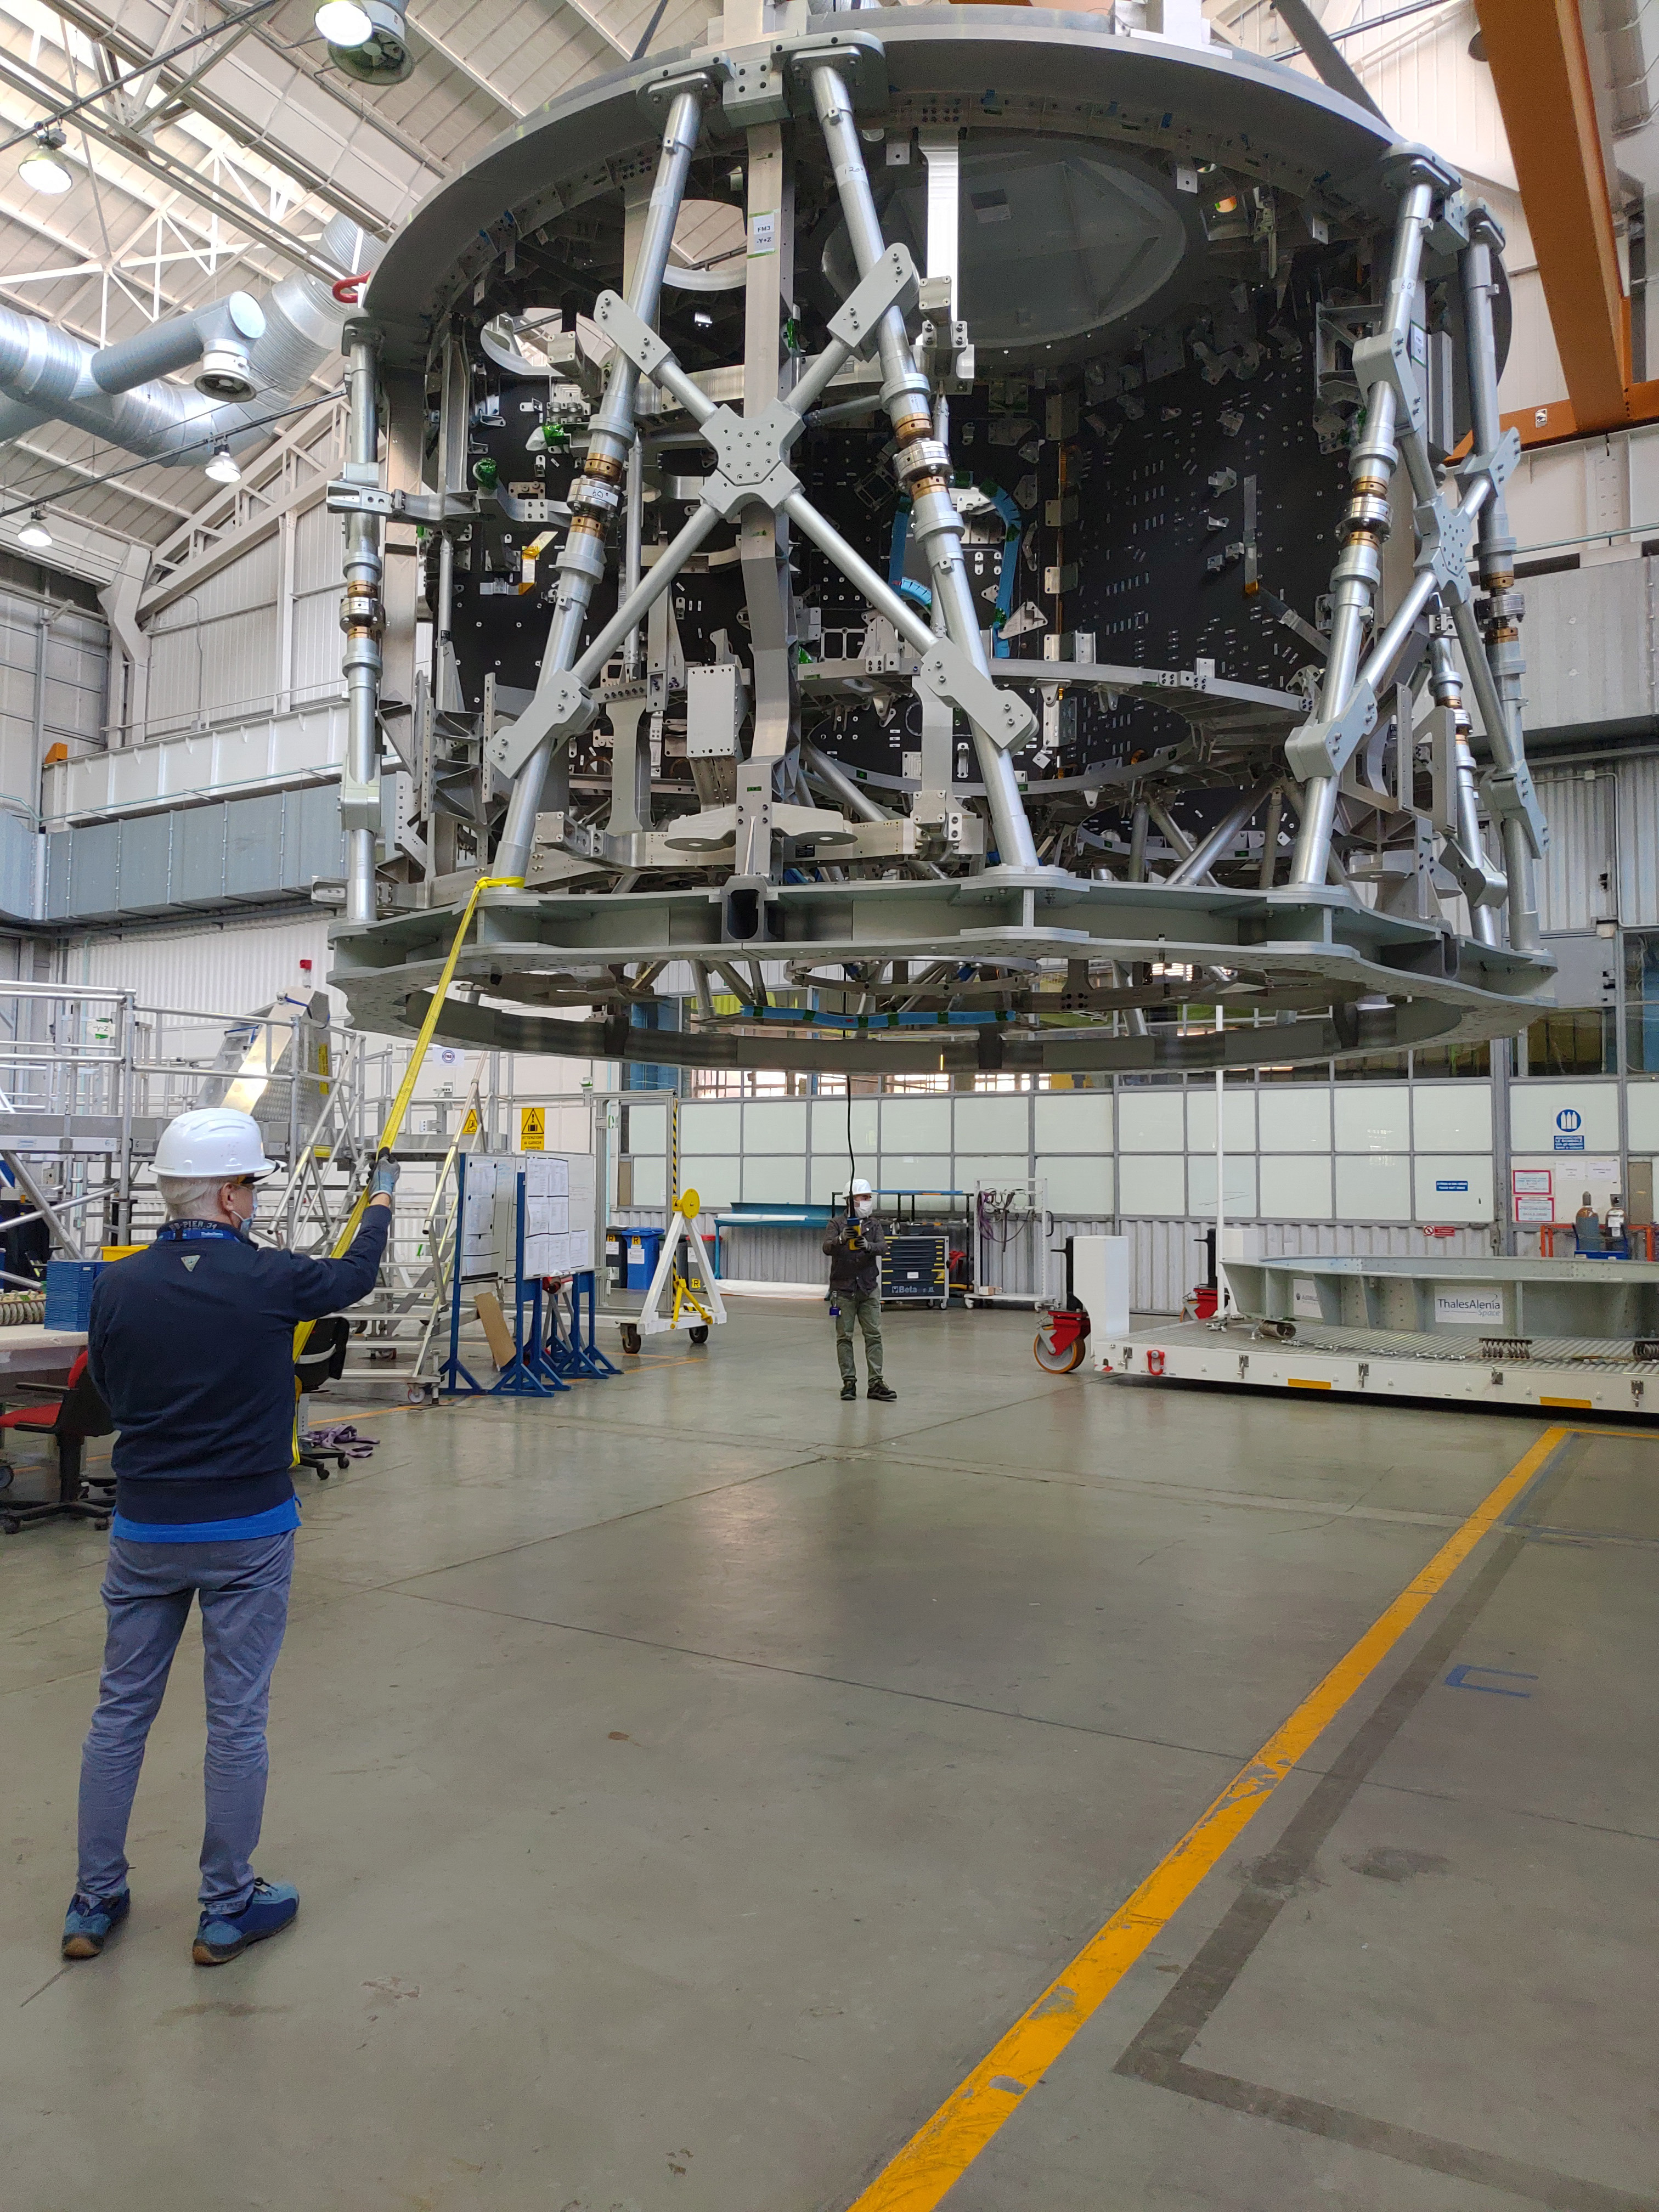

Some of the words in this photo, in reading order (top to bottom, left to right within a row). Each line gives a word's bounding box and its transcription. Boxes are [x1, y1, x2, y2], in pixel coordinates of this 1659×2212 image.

[633, 1236, 639, 1244] R
[1437, 1299, 1500, 1310] ThalesAlenia
[1478, 1309, 1500, 1317] Space
